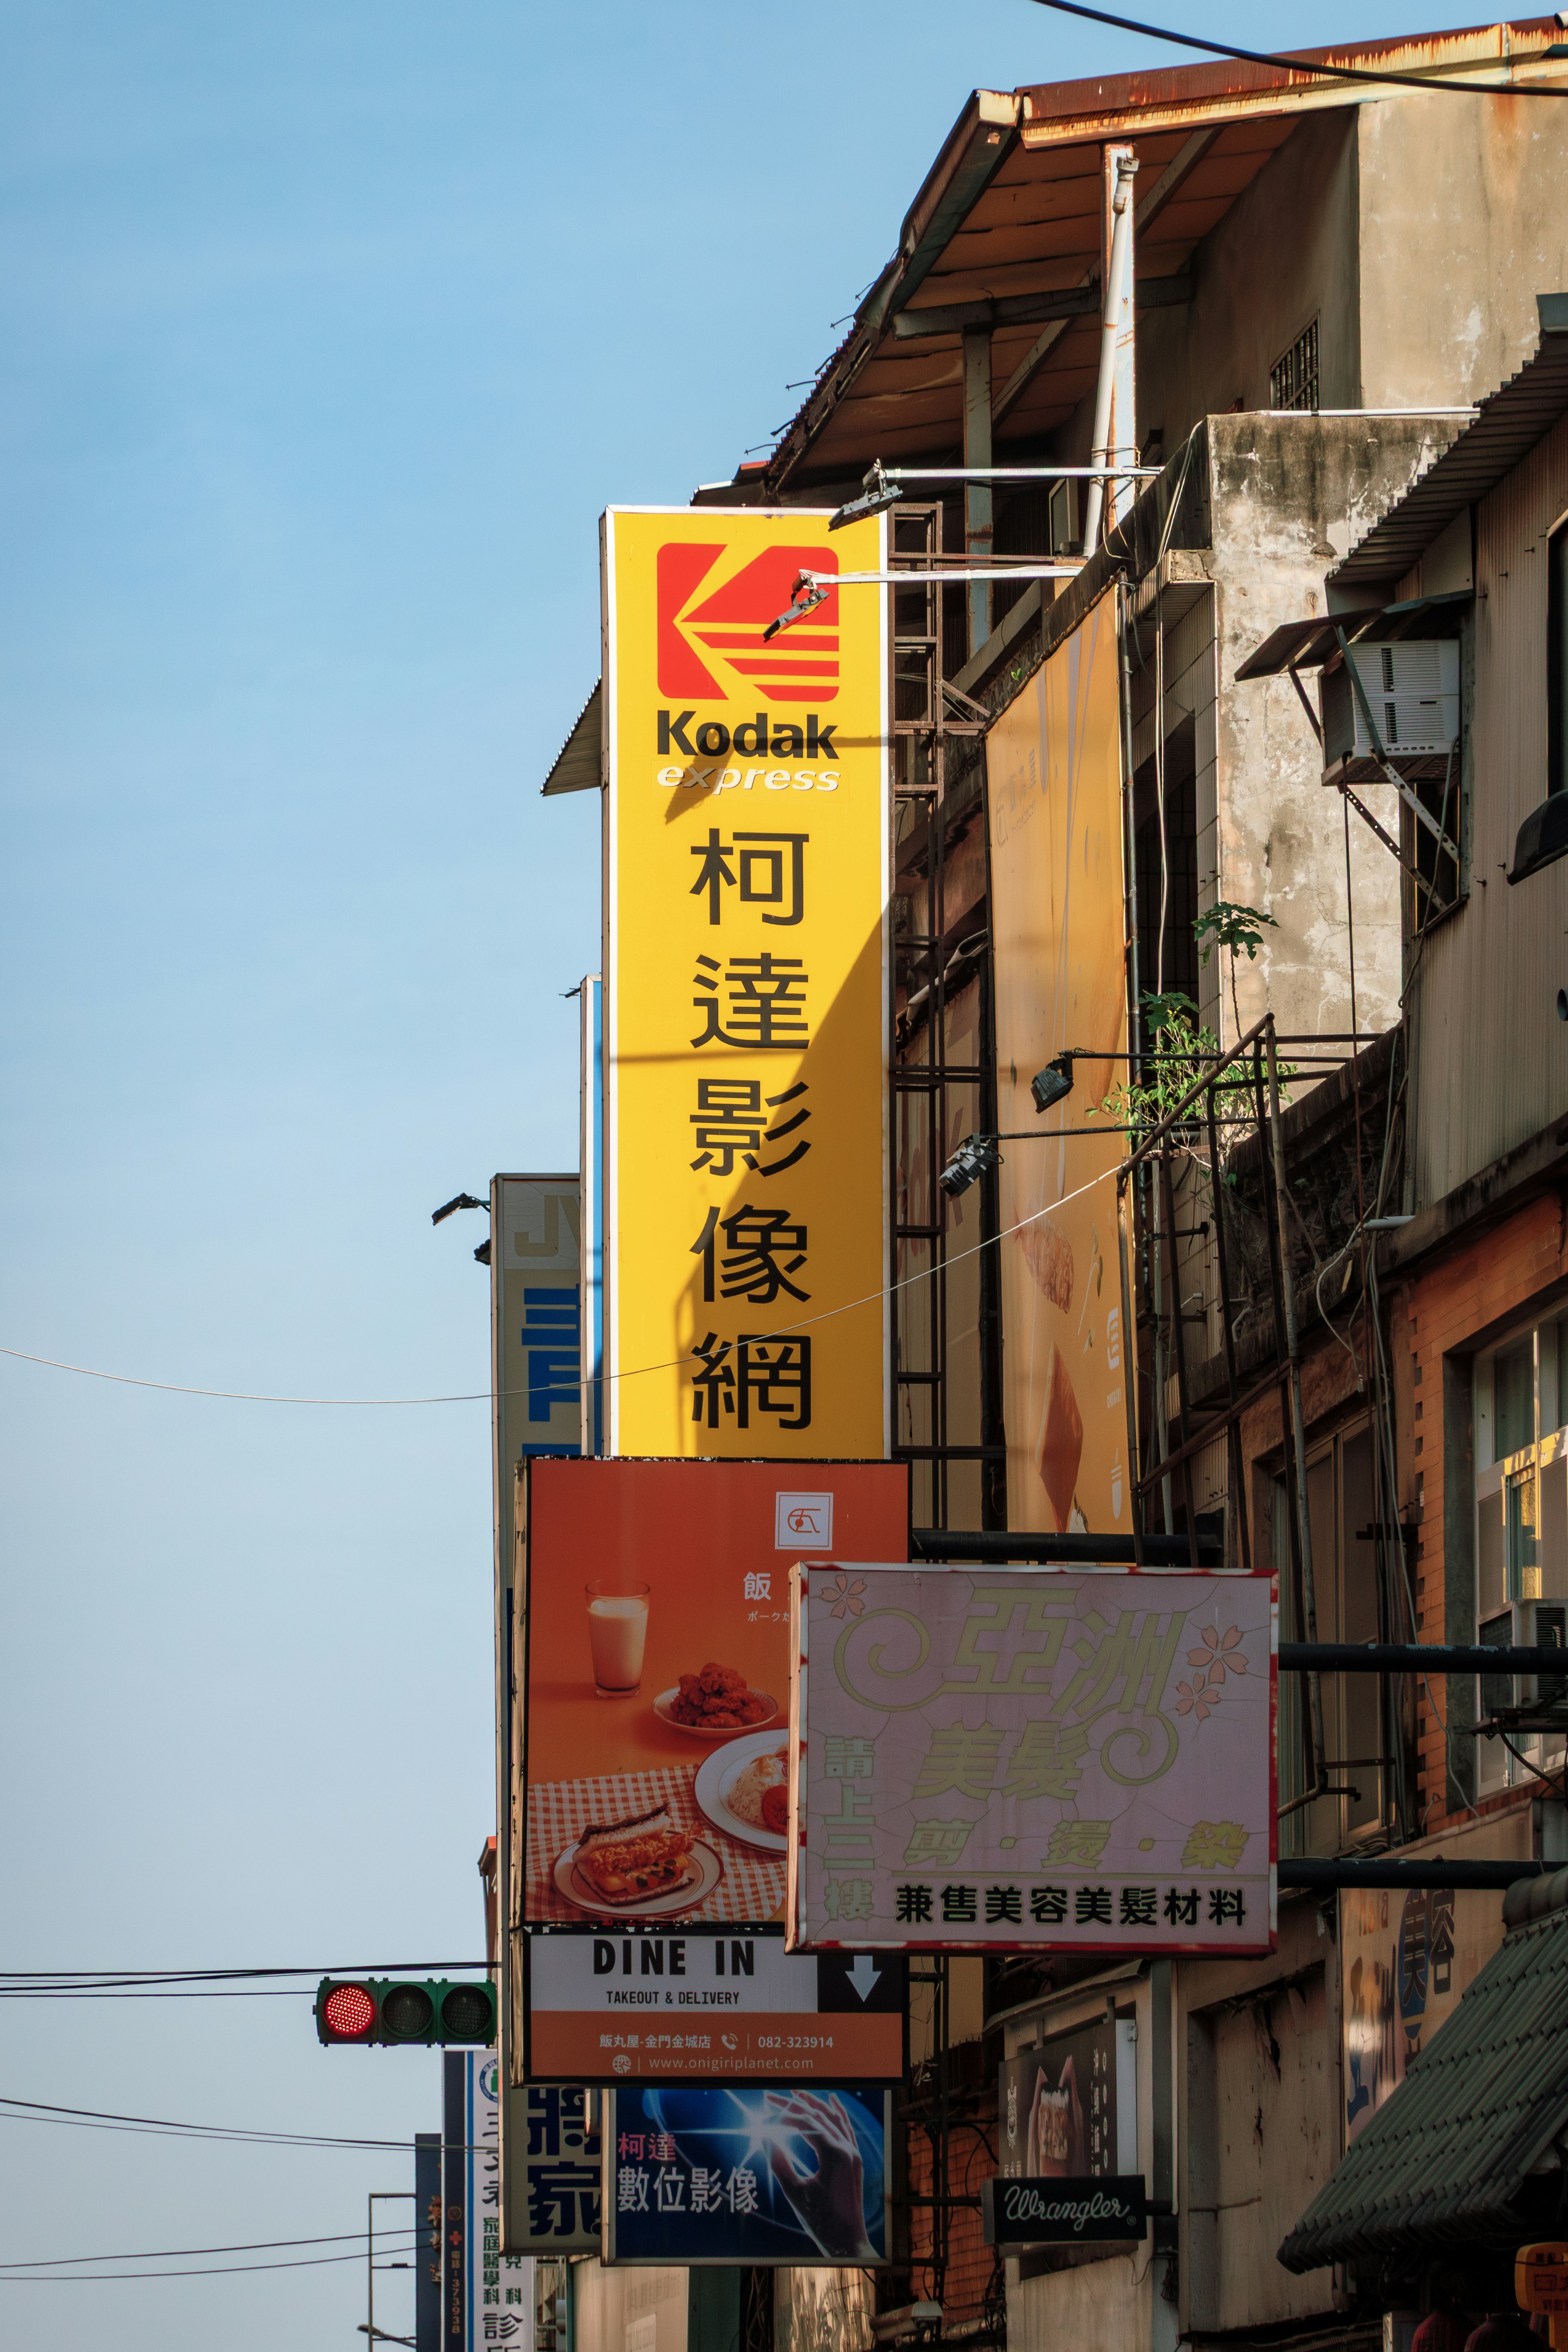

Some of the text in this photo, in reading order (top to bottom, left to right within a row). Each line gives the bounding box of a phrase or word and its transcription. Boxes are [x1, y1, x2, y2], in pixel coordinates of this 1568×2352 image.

[657, 710, 839, 759] Kodak
[657, 766, 841, 795] express
[689, 828, 812, 1430] 柯達影像網
[944, 1588, 1189, 1717] 亞洲
[912, 1721, 1091, 1801] 美髮
[824, 1736, 876, 1921] 請上二樓
[895, 1884, 1247, 1927] 兼售美容美髮材料
[594, 1939, 754, 1976] DINE IN
[606, 1991, 740, 2004] TAKEOUT & DELIVERY
[649, 2056, 814, 2072] www.onigiriplanet.com
[758, 2036, 834, 2048] 082-323914
[618, 2132, 676, 2161] 柯達
[617, 2165, 759, 2213] 數位影像
[1004, 2186, 1130, 2231] Wrangler
